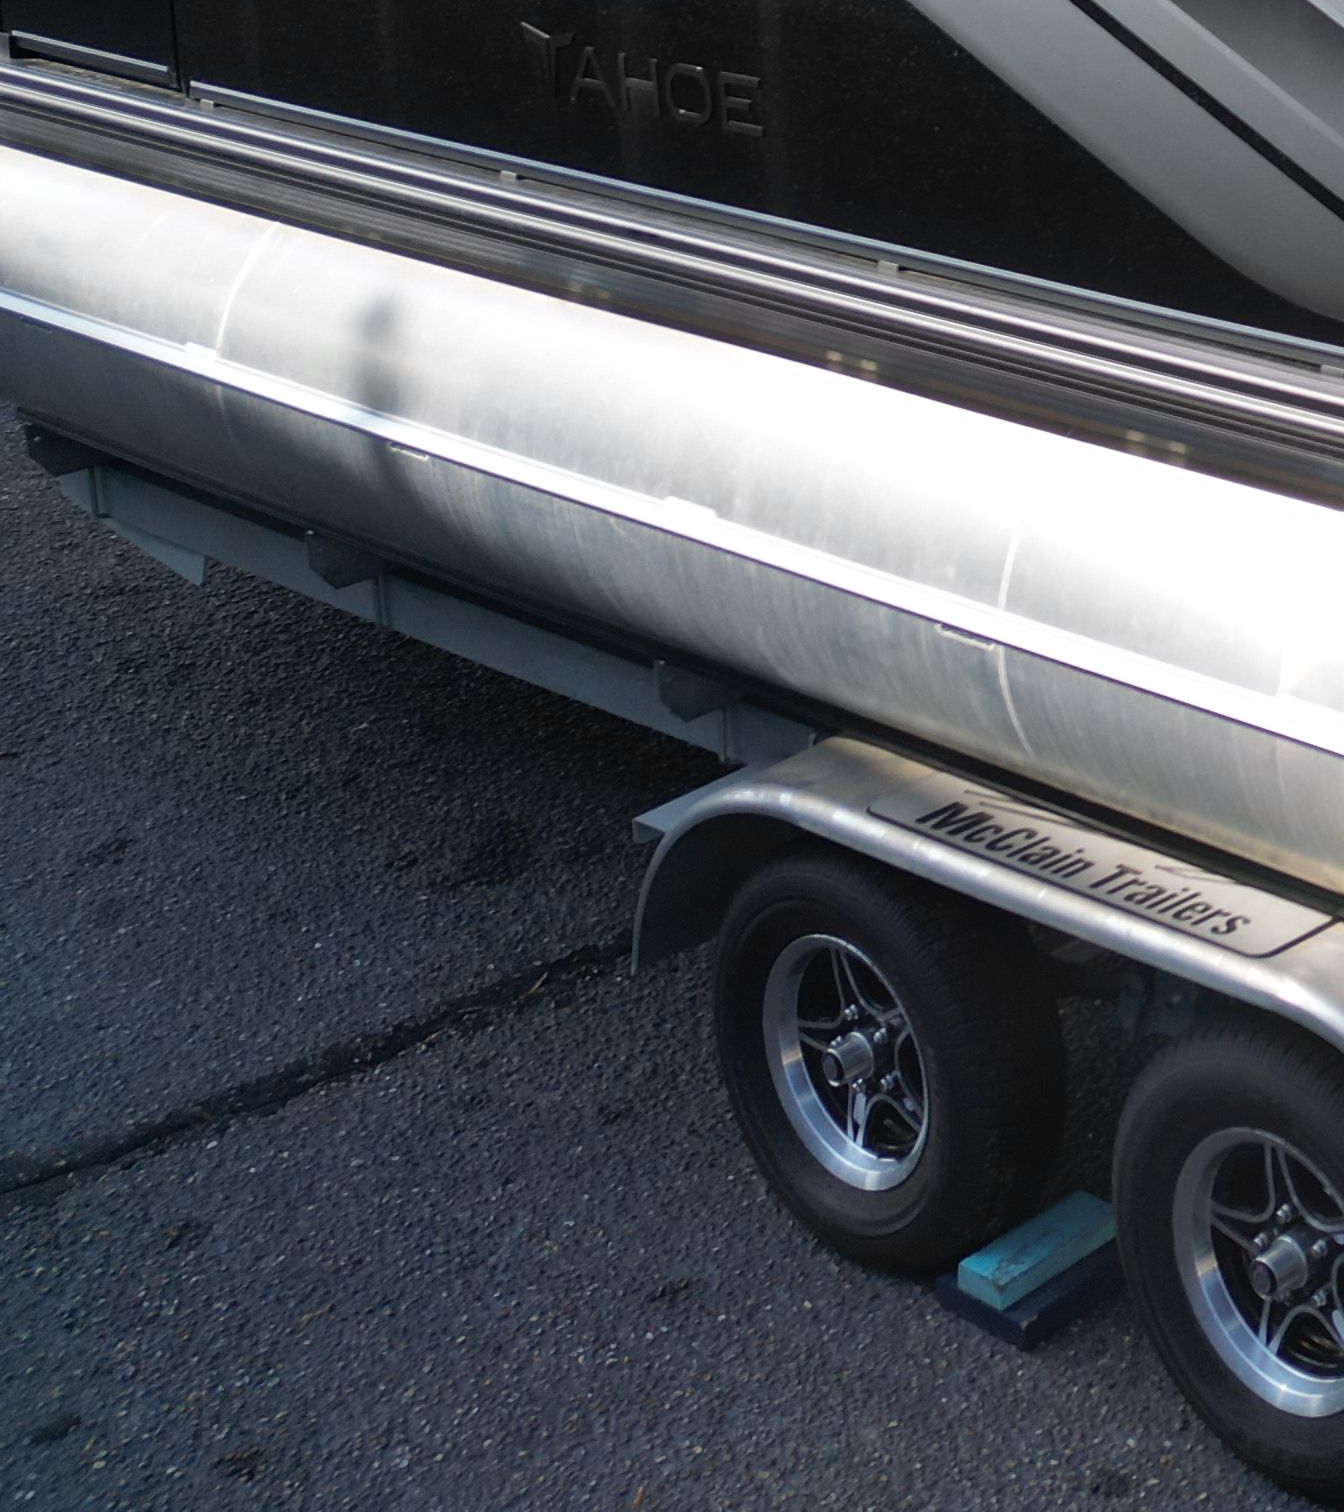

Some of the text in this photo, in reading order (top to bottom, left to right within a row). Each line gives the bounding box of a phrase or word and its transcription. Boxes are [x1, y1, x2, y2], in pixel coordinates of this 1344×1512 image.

[519, 21, 766, 138] TAHOE
[916, 800, 1252, 936] McClain Trailers
